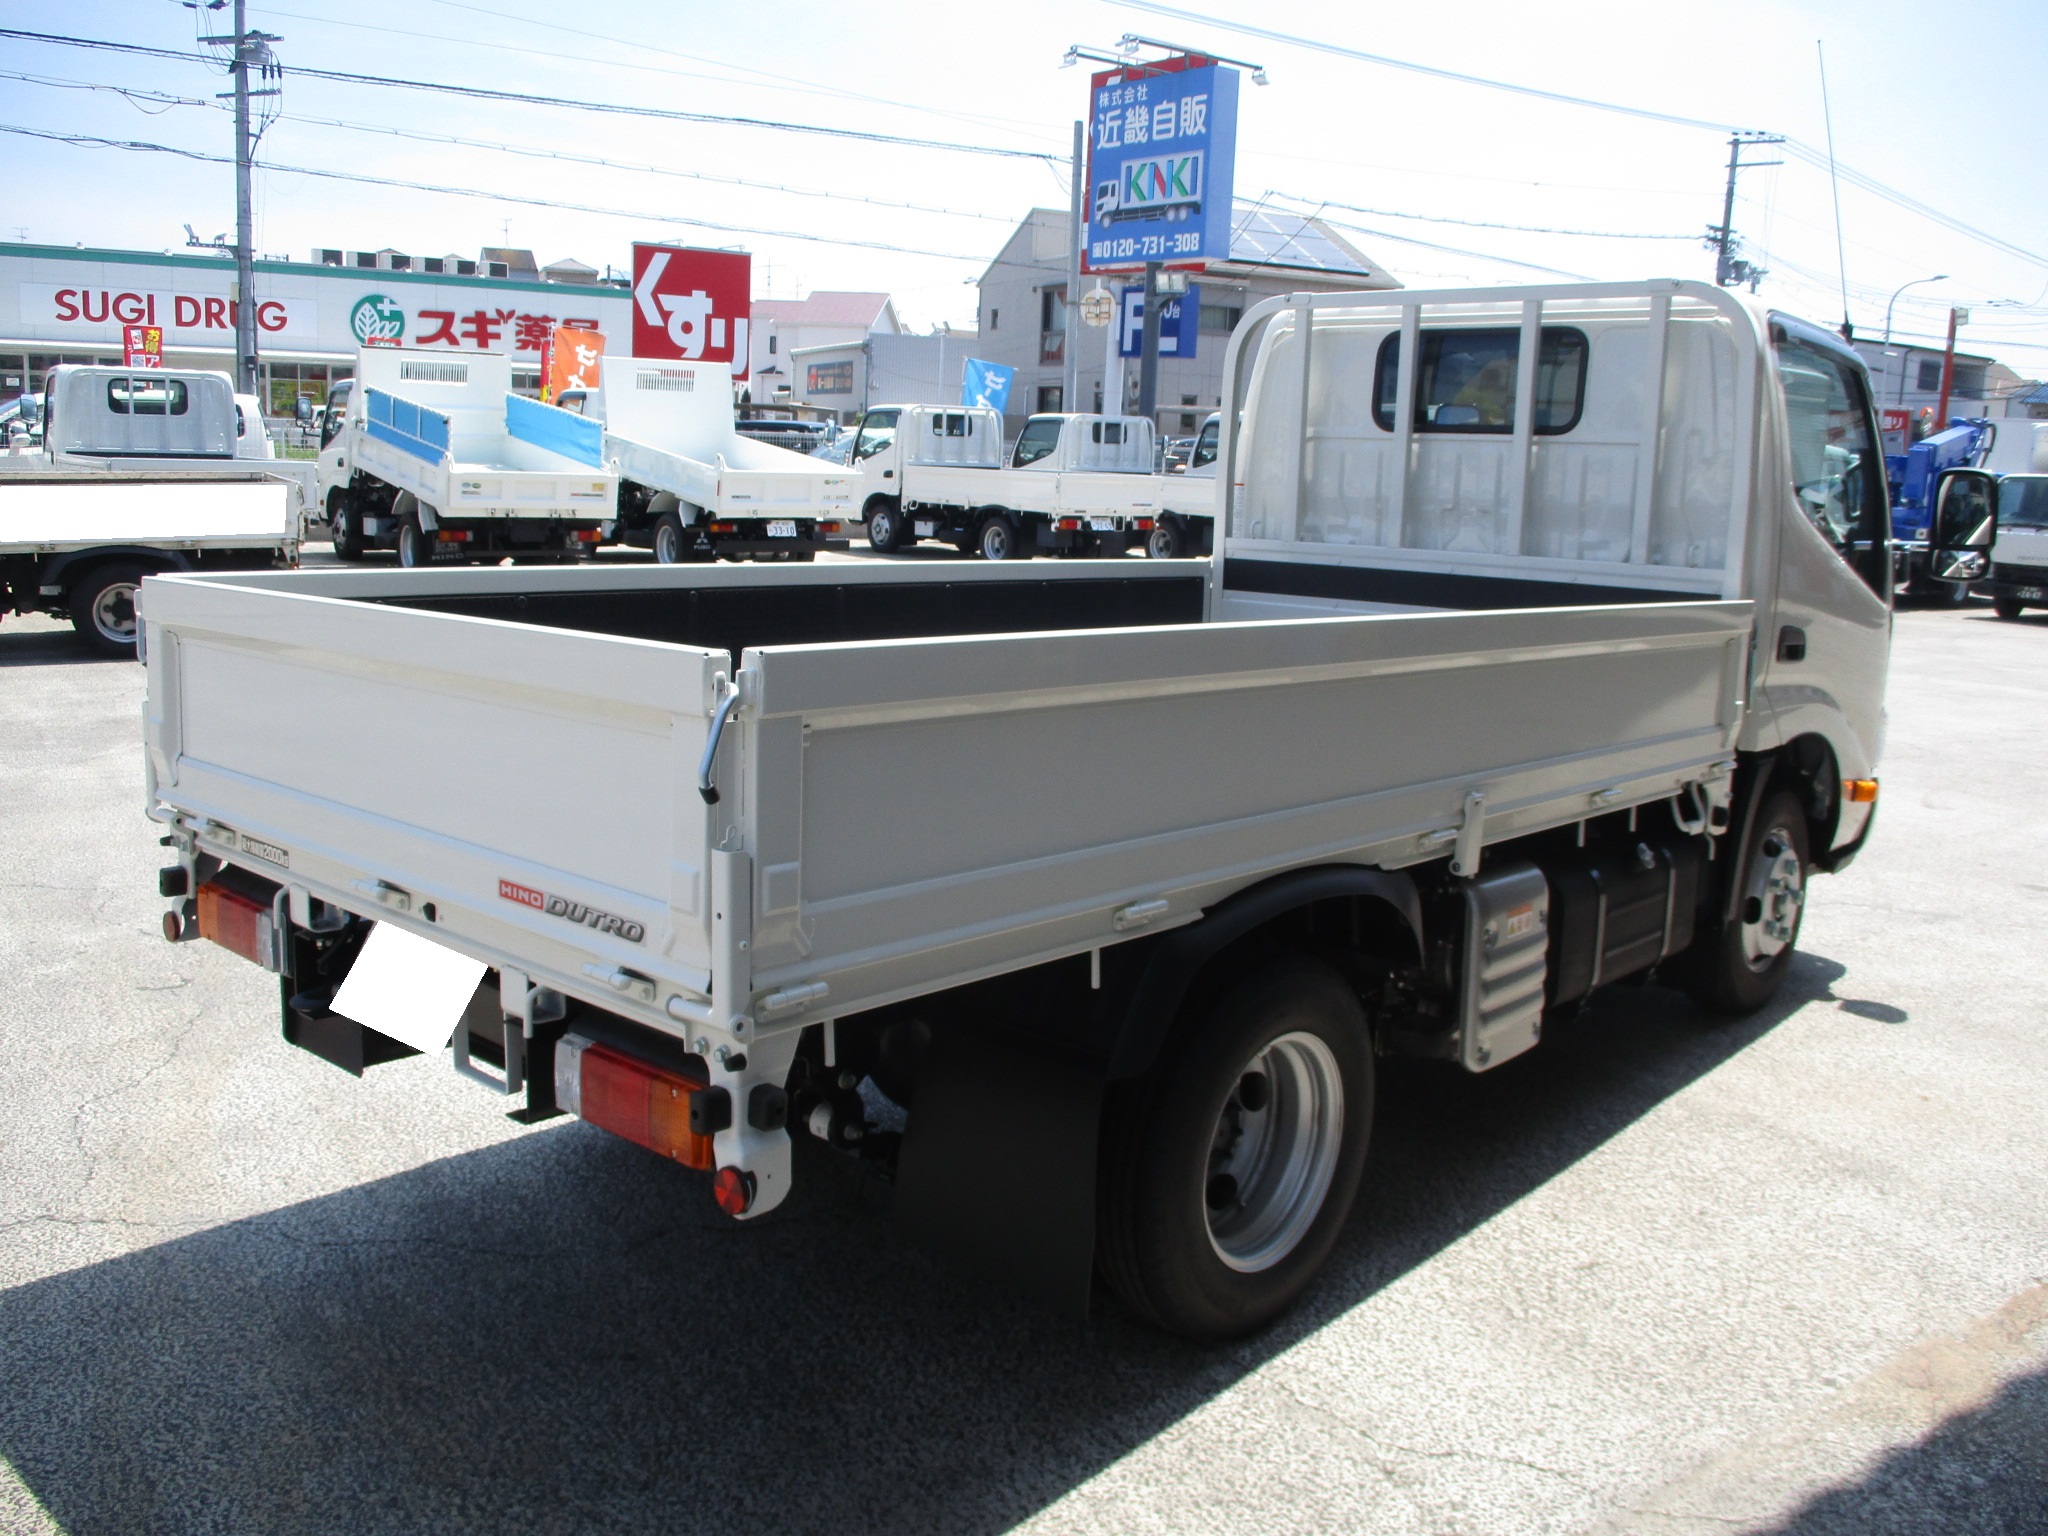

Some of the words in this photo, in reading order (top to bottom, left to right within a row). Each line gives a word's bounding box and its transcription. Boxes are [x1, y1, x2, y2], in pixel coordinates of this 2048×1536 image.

[1099, 84, 1148, 107] 株式会社
[1097, 93, 1208, 150] 近畿自販
[1103, 232, 1200, 257] 0120-731-308
[54, 288, 155, 325] SUGI
[634, 252, 748, 375] くすり
[501, 883, 542, 907] HINO
[545, 894, 645, 943] DUTRO
